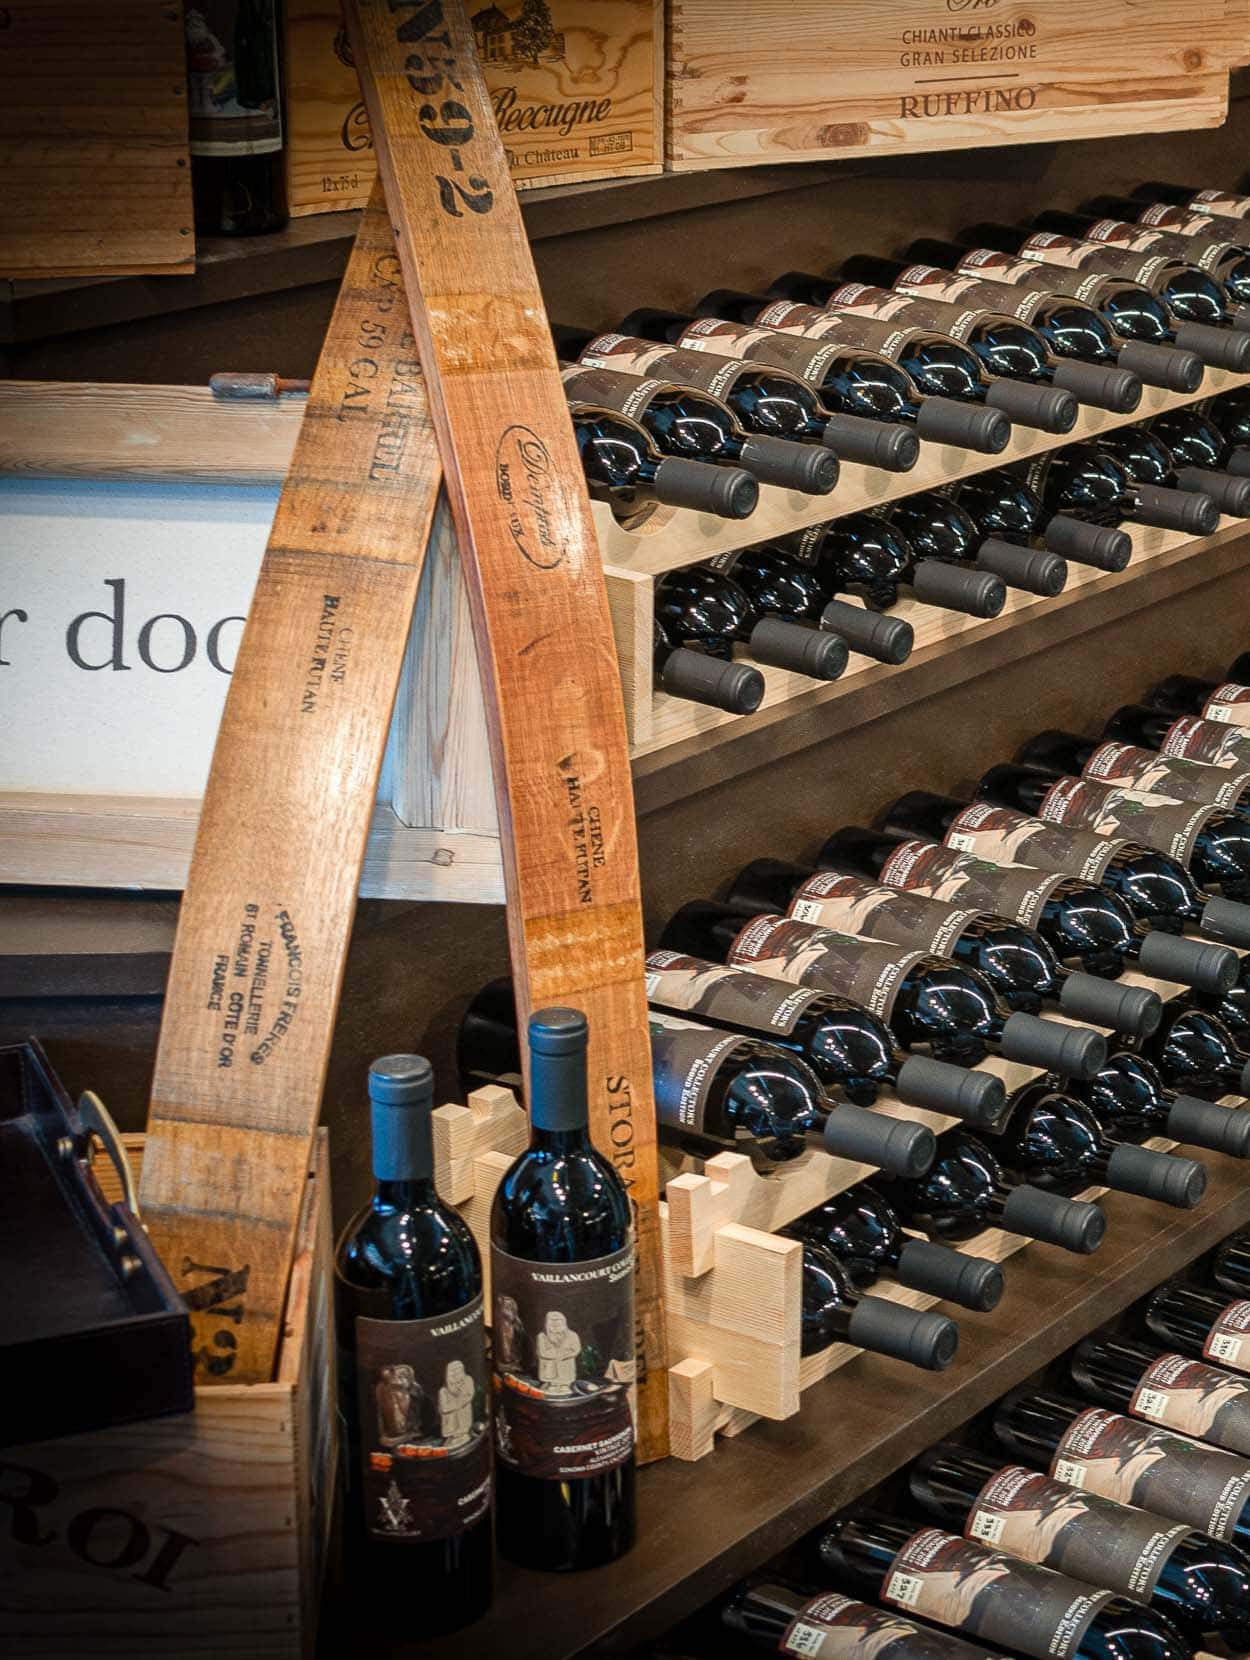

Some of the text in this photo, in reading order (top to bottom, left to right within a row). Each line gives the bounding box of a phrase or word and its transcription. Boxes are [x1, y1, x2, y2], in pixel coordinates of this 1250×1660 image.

[900, 45, 1037, 67] GRAN SELEZIONE
[902, 23, 1036, 45] CHIANTI CLASSICO
[900, 87, 1036, 118] RUFFINO
[587, 806, 606, 868] CHENE
[234, 924, 256, 978] ROMAIN
[209, 955, 229, 1012] FRANCE
[244, 941, 273, 1035] TONNELLERIE
